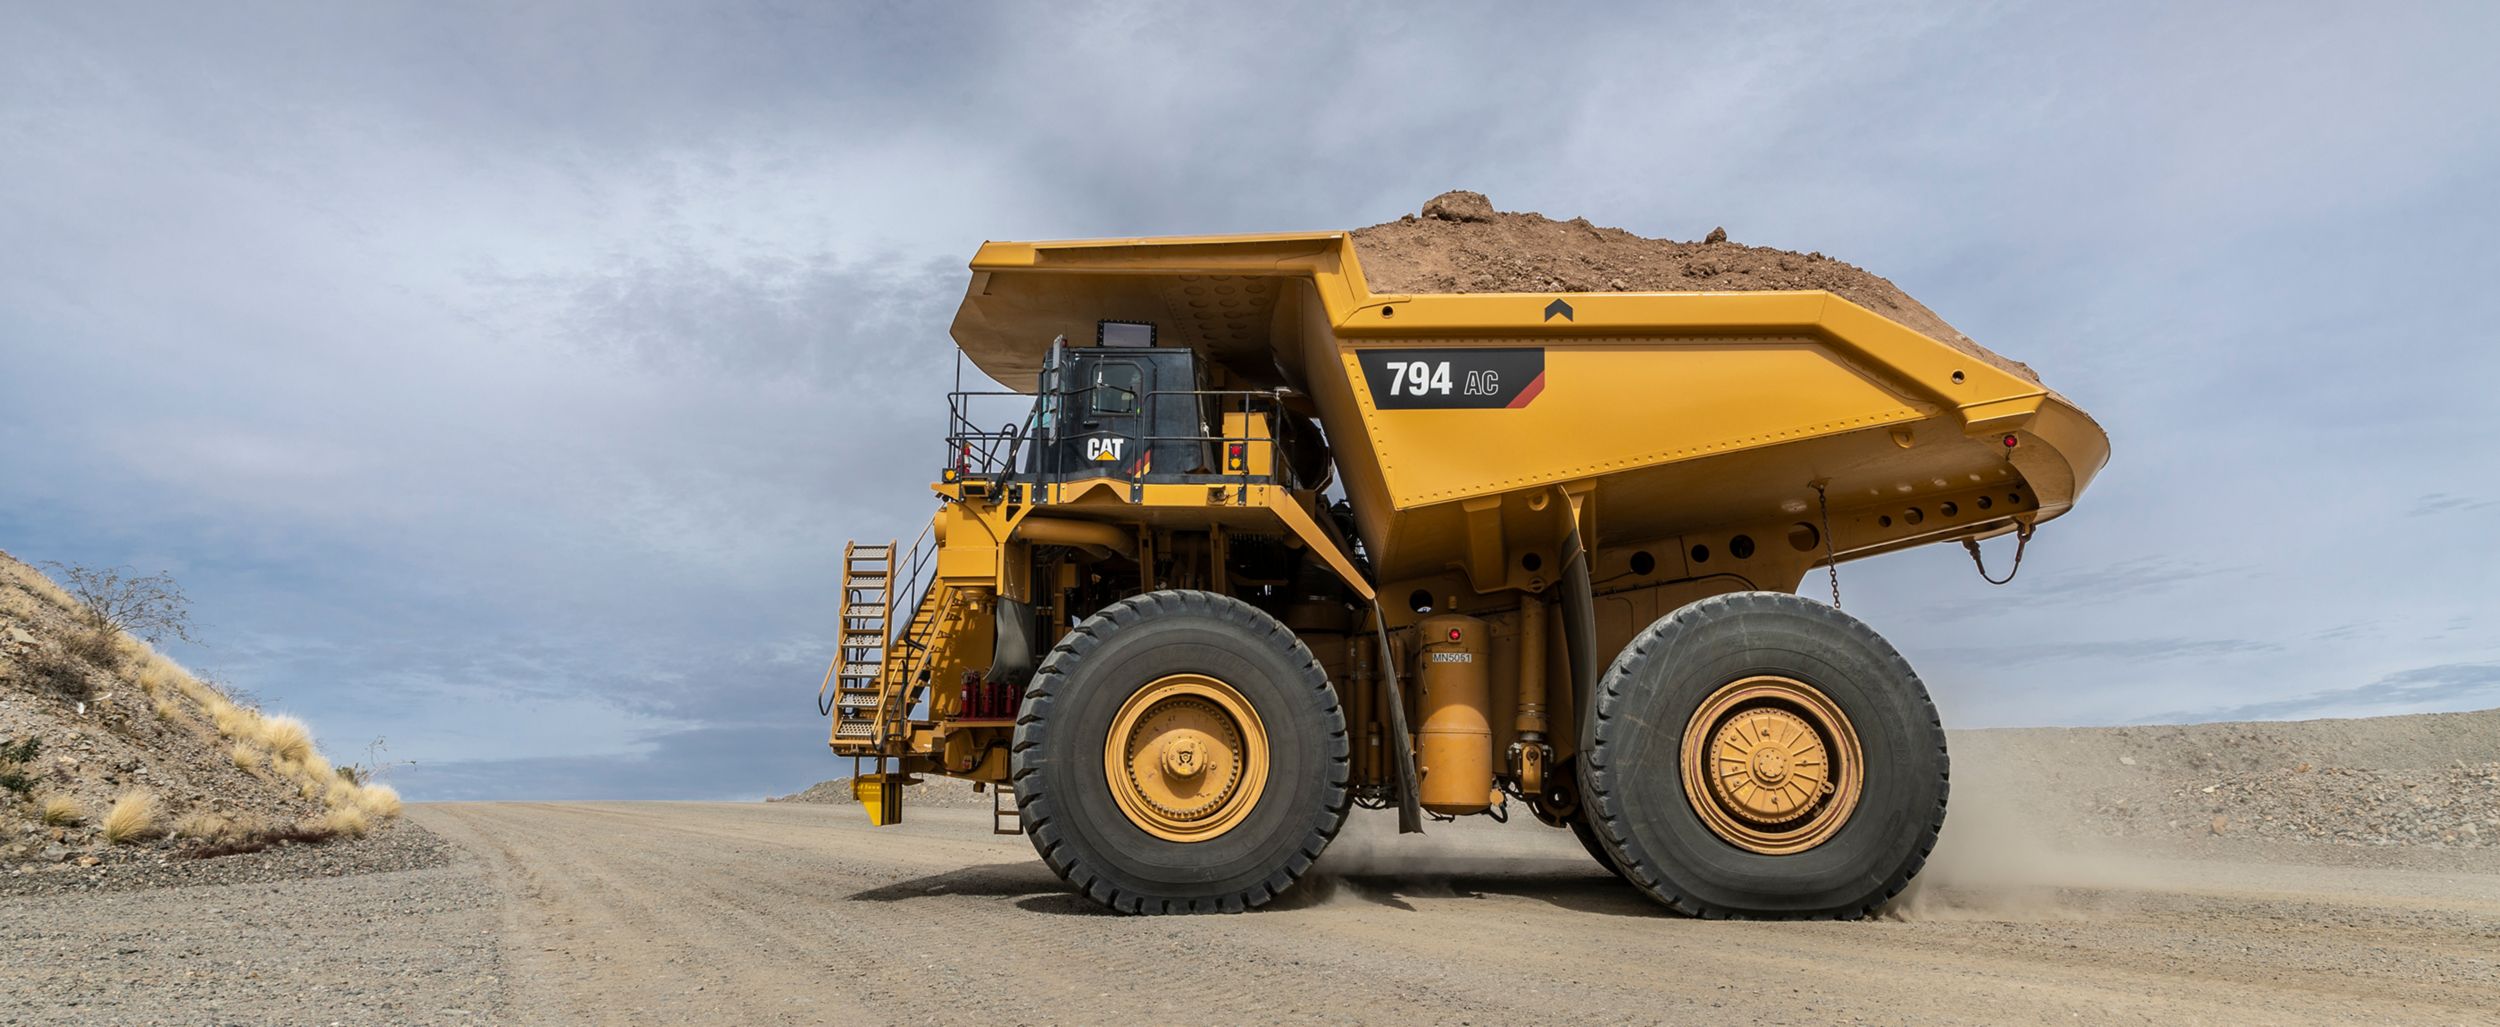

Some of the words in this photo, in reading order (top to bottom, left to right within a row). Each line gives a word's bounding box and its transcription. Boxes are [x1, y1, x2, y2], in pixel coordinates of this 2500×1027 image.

[1386, 361, 1453, 396] 794
[1463, 370, 1499, 396] AC
[1087, 438, 1124, 461] CAT
